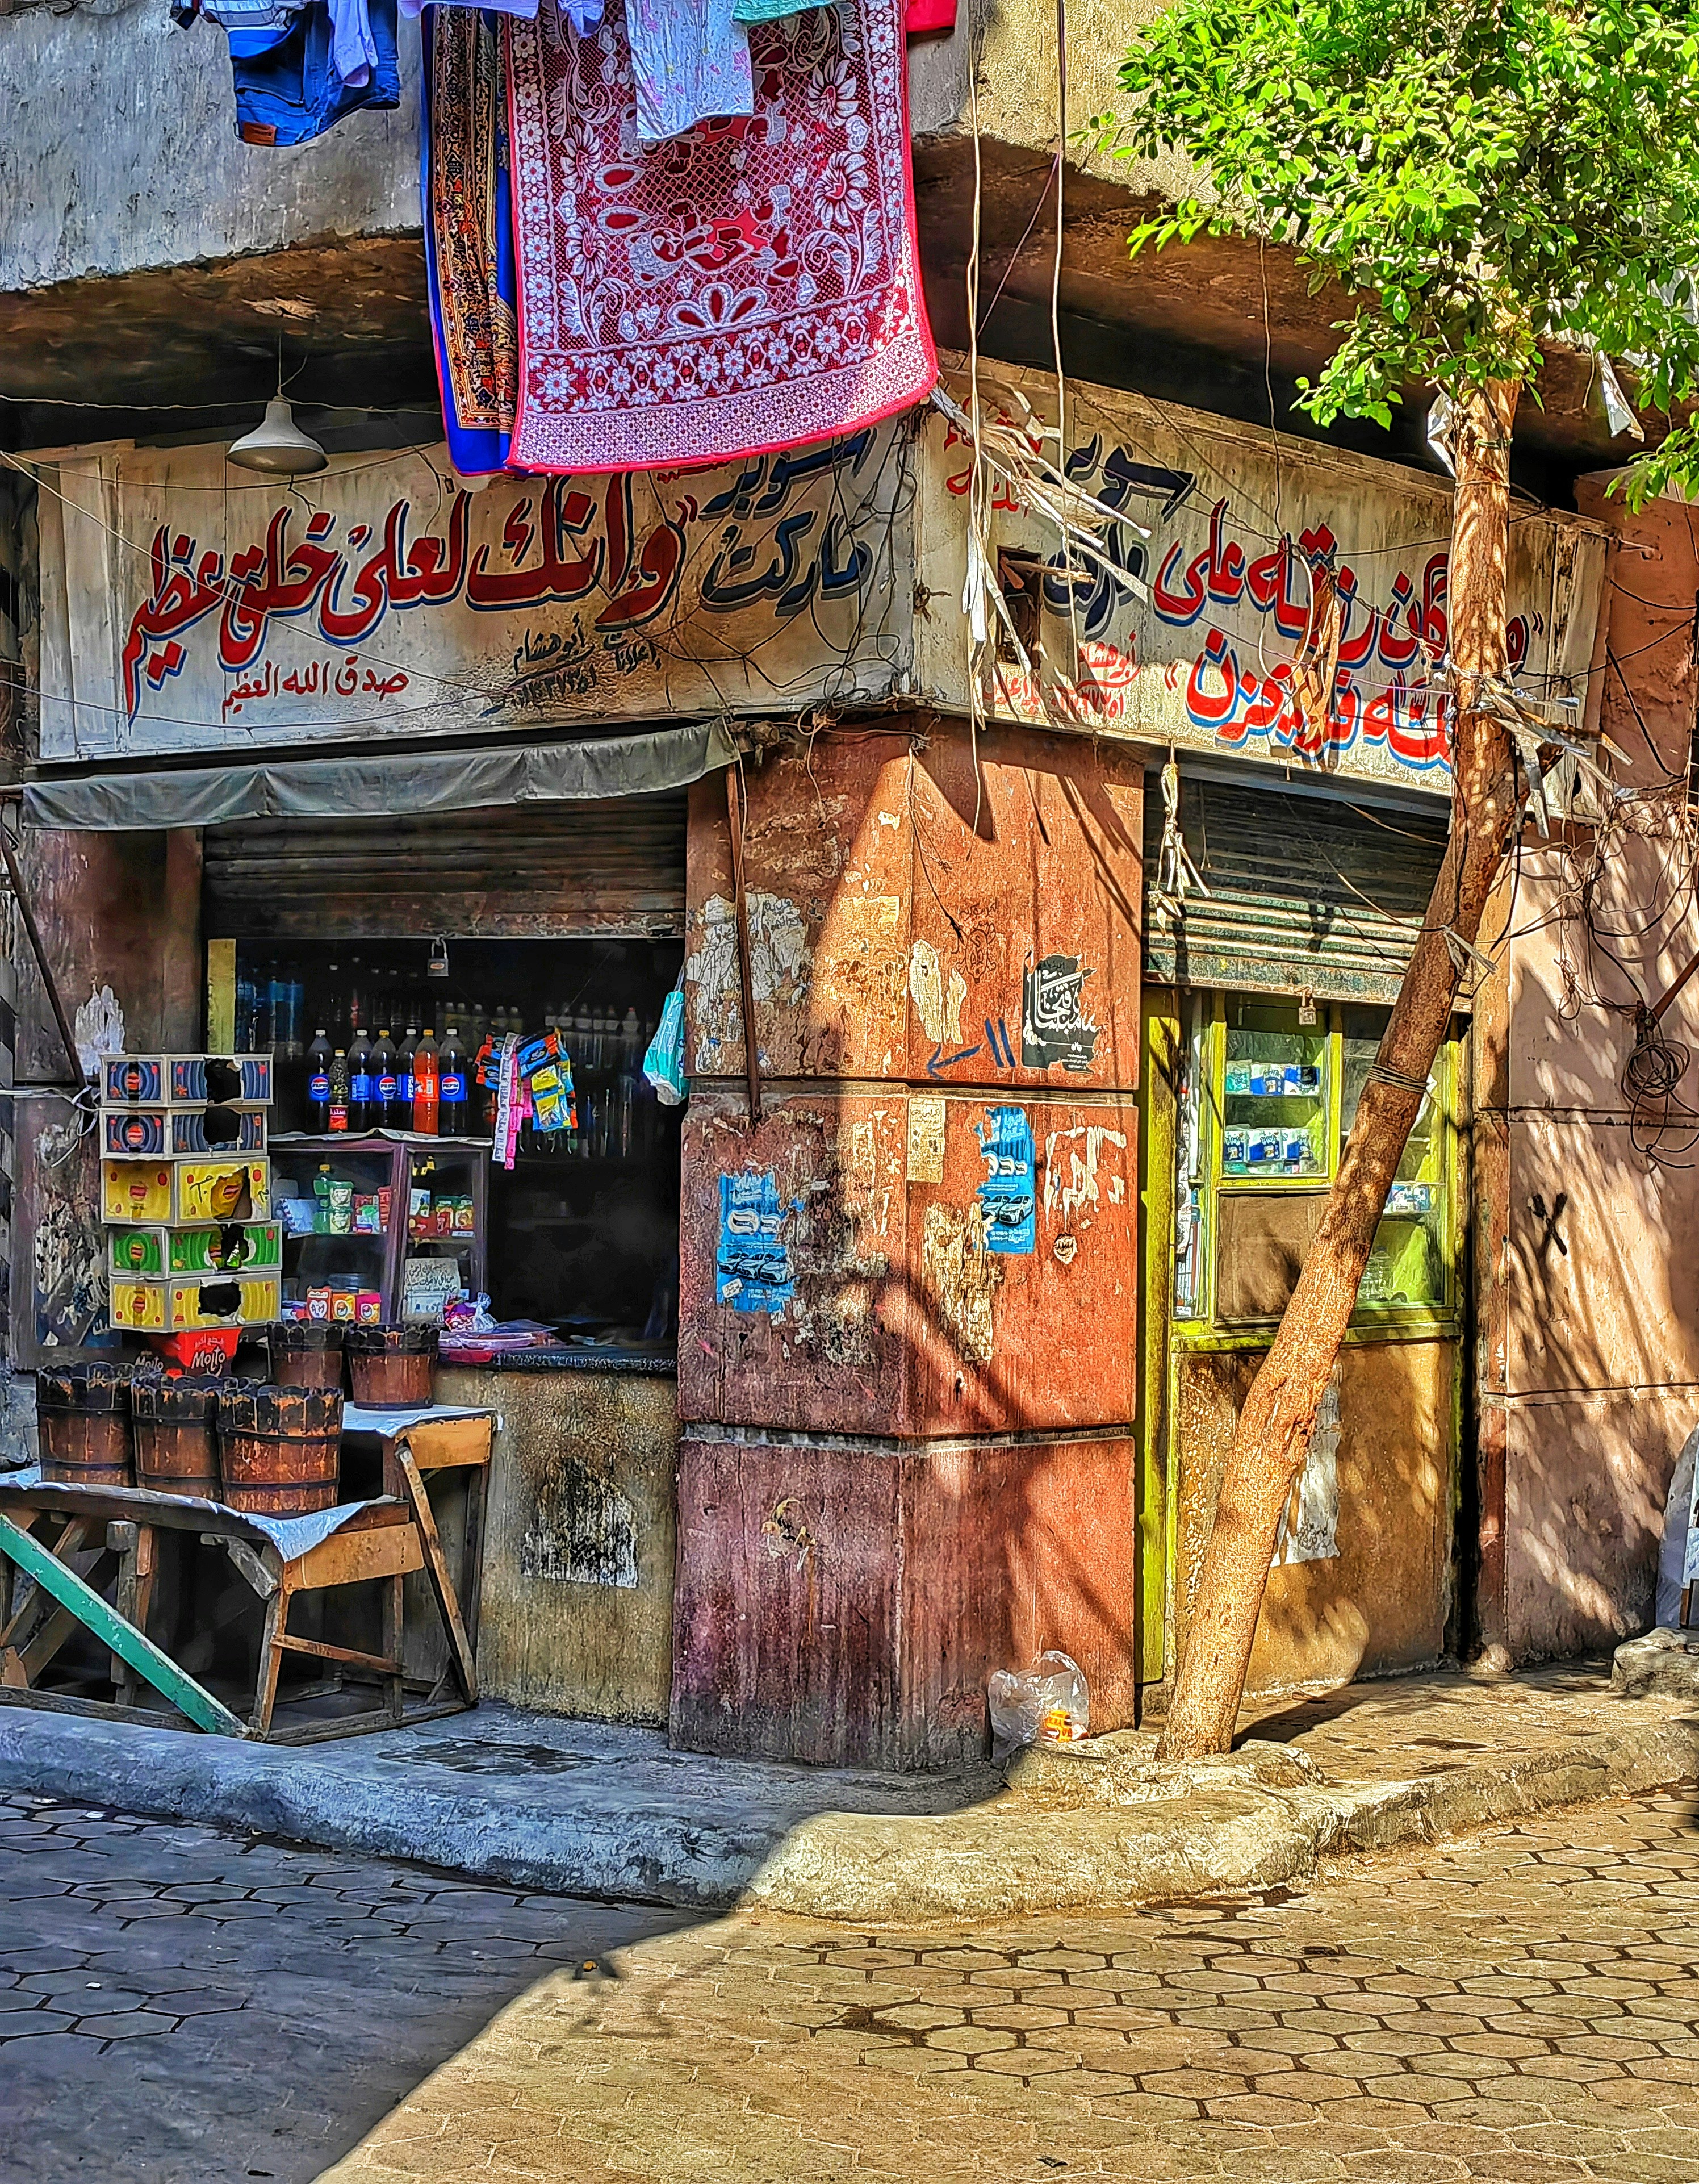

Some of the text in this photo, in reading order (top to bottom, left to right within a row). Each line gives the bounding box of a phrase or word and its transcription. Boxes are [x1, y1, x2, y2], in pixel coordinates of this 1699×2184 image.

[218, 506, 343, 672] خلق
[700, 510, 873, 617] ماركت
[1153, 496, 1245, 627] على
[123, 524, 226, 734] عظيم
[222, 655, 409, 724] صدق الله العظيم
